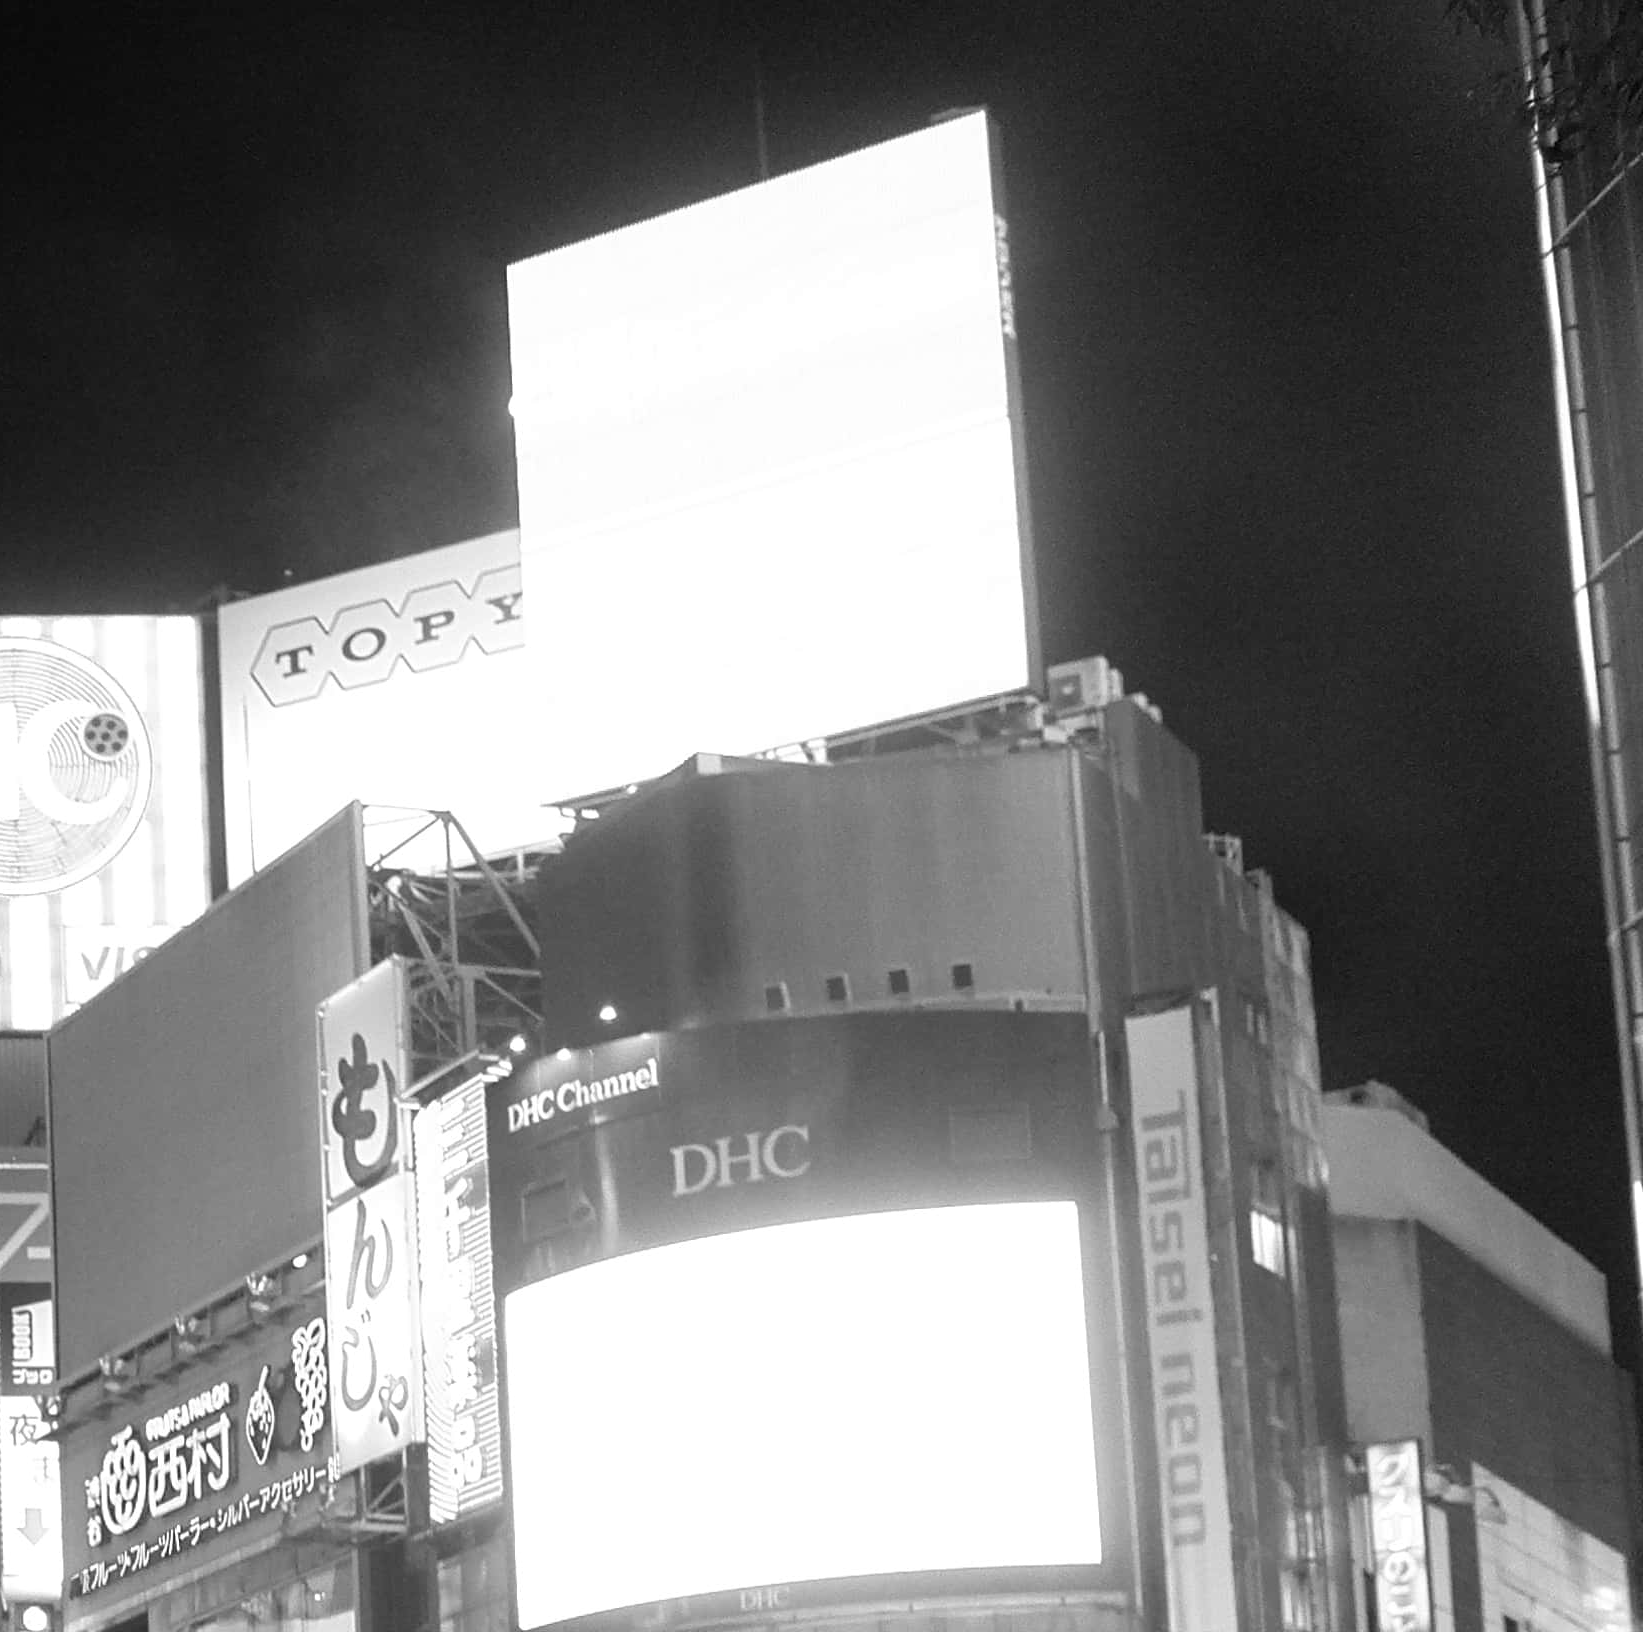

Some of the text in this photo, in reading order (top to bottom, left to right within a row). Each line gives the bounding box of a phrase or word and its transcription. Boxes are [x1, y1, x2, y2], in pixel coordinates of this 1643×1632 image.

[274, 591, 524, 678] TOPY
[508, 1058, 659, 1132] DHC Channel
[670, 1125, 812, 1197] DHC
[331, 1032, 408, 1437] もんじゃ
[1139, 1089, 1209, 1549] Taisei neon
[147, 1411, 232, 1518] 西村
